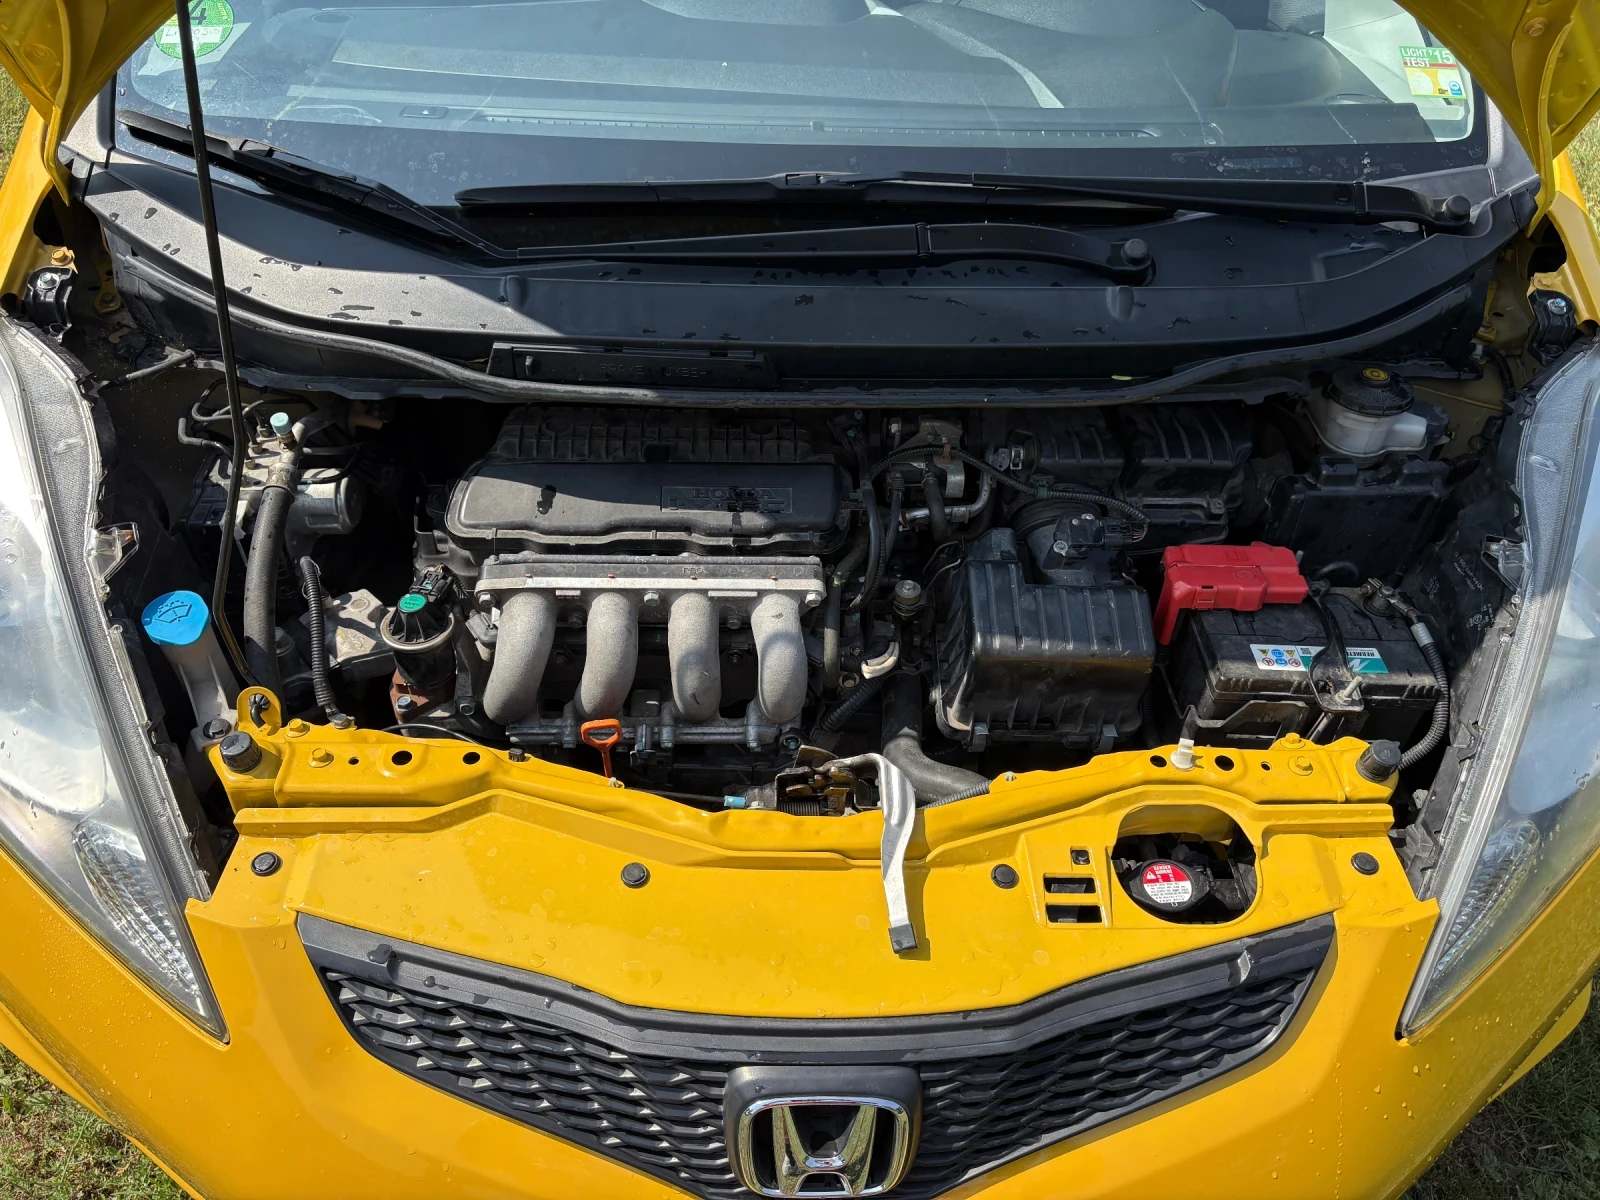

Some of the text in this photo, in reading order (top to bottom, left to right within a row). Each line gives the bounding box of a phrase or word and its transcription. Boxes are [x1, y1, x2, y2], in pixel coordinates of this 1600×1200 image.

[1401, 48, 1427, 57] LICHT
[1404, 57, 1430, 68] TEST
[692, 487, 777, 500] HONDA
